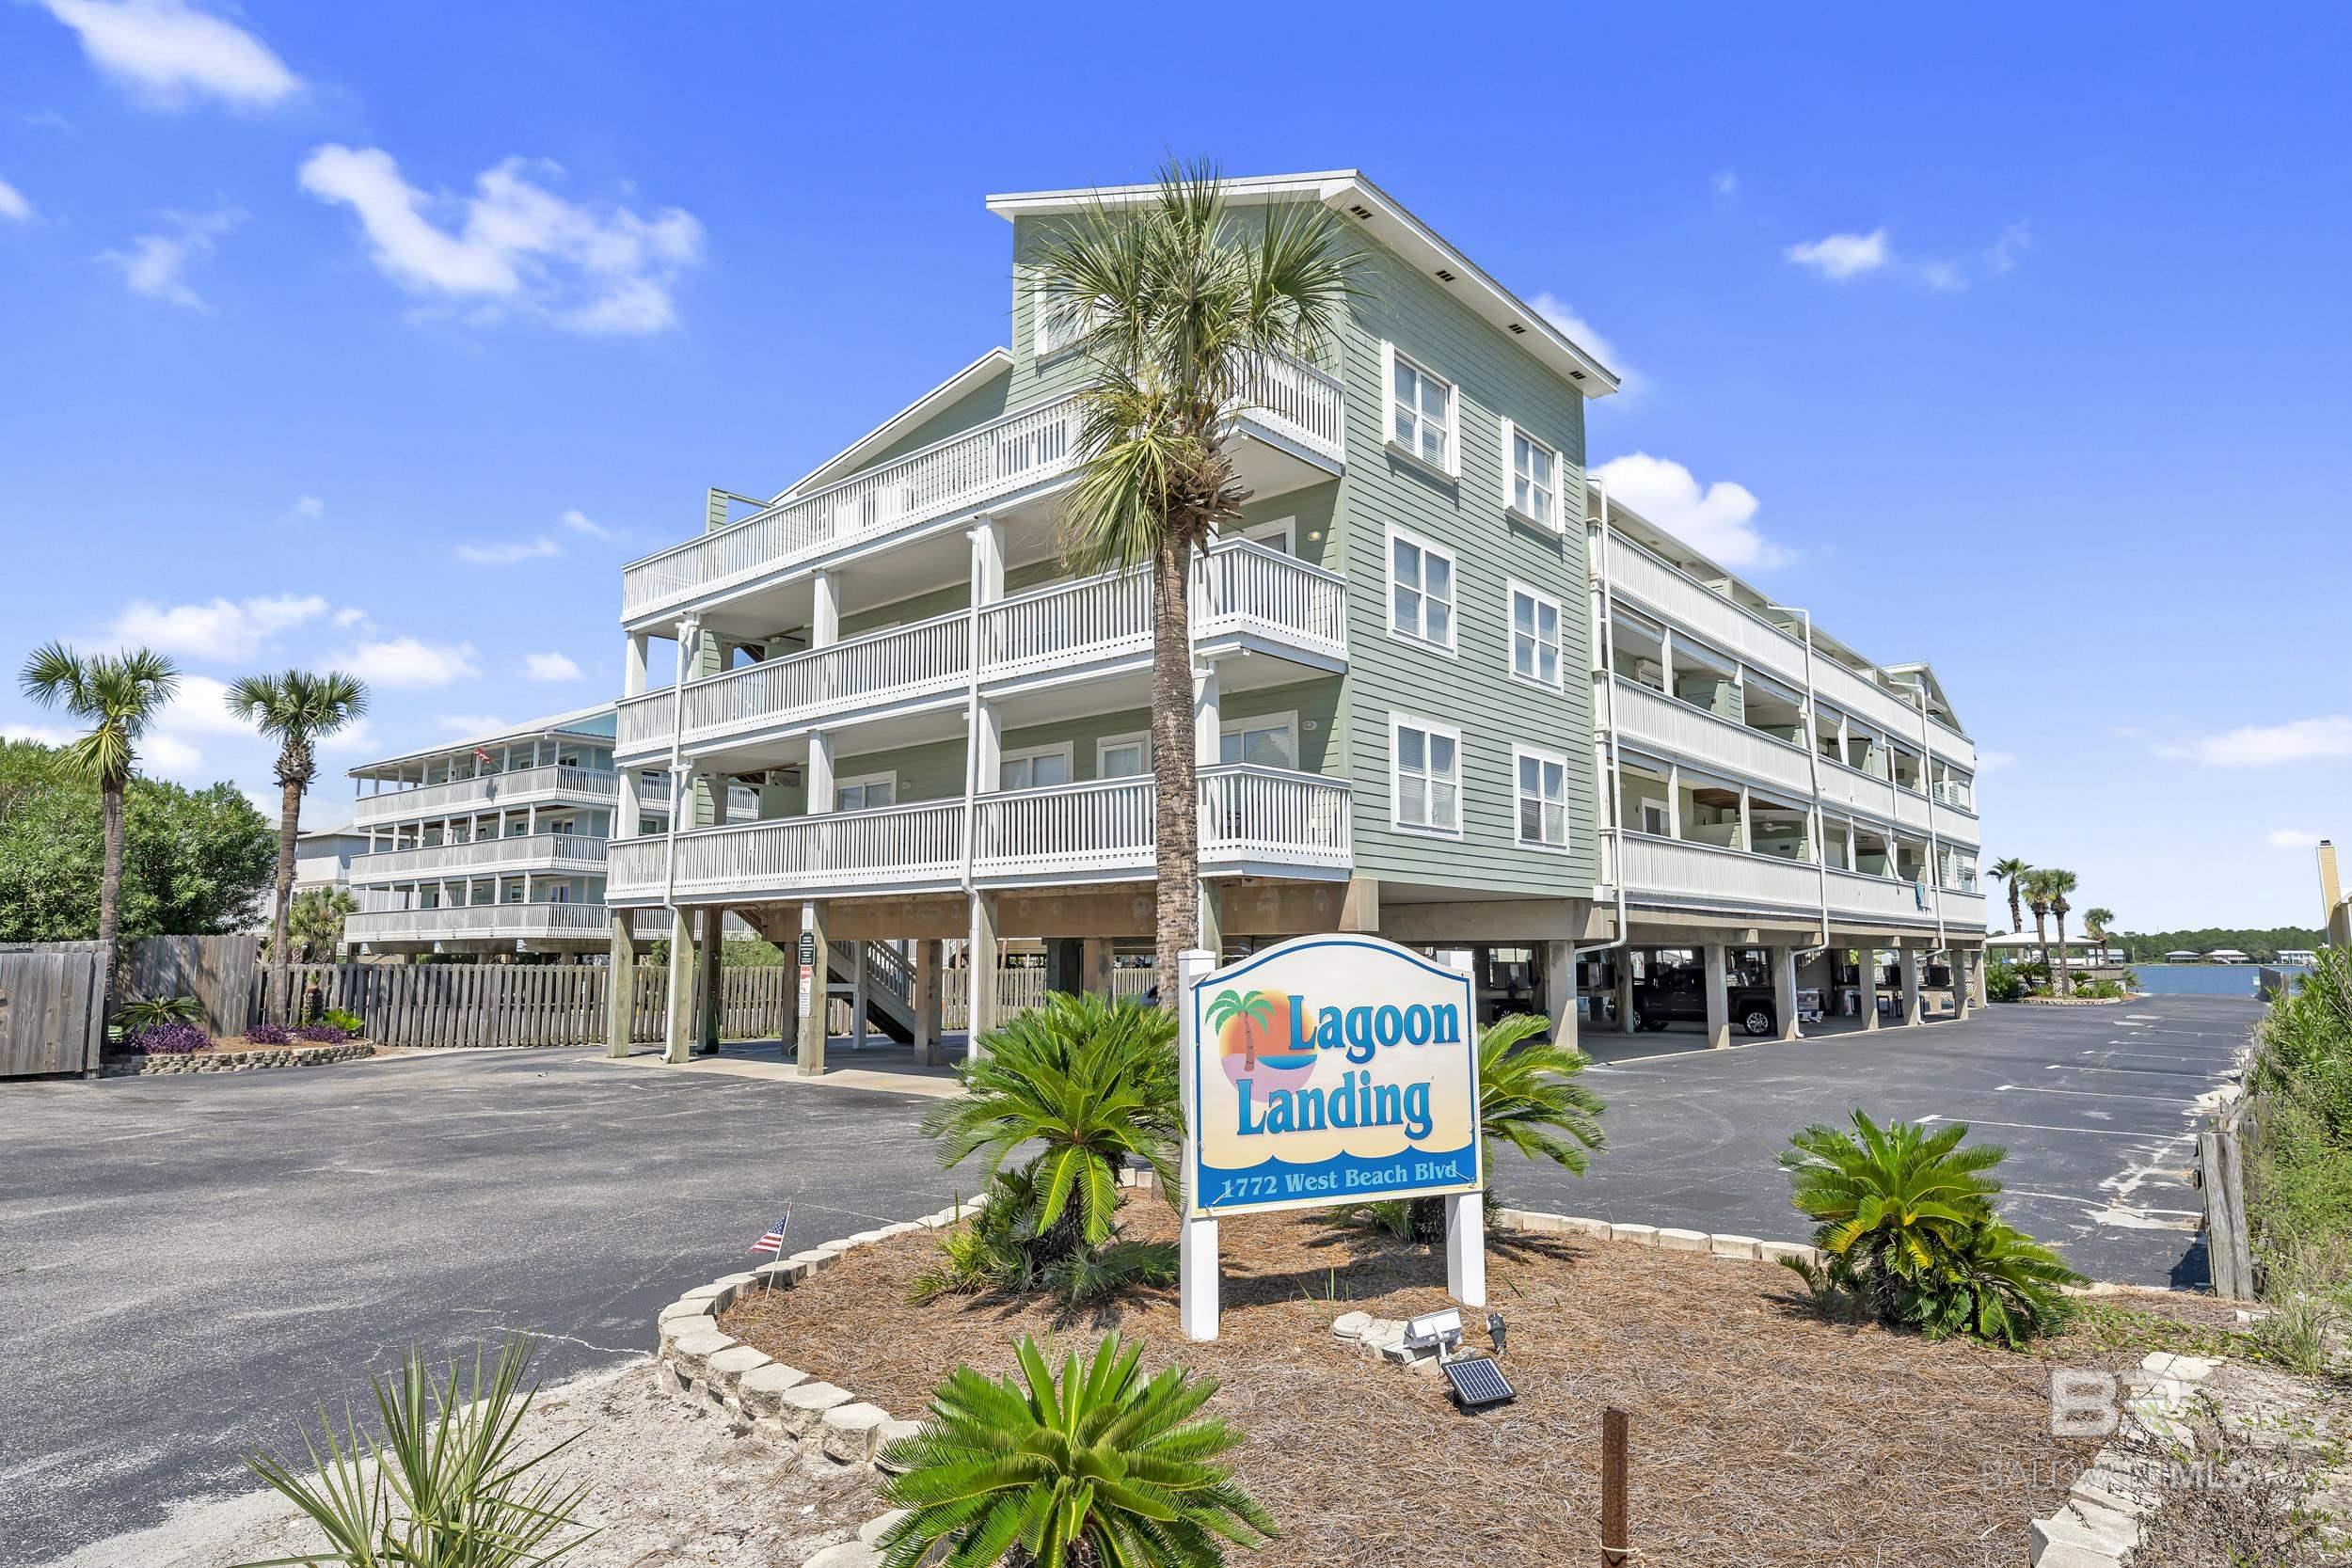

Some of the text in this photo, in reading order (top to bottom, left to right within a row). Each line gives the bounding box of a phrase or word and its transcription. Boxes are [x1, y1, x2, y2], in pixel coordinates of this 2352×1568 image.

[1287, 994, 1461, 1065] Lagoon
[1235, 1069, 1434, 1141] Landing
[1221, 1160, 1457, 1199] 1772 West Beach Blvd
